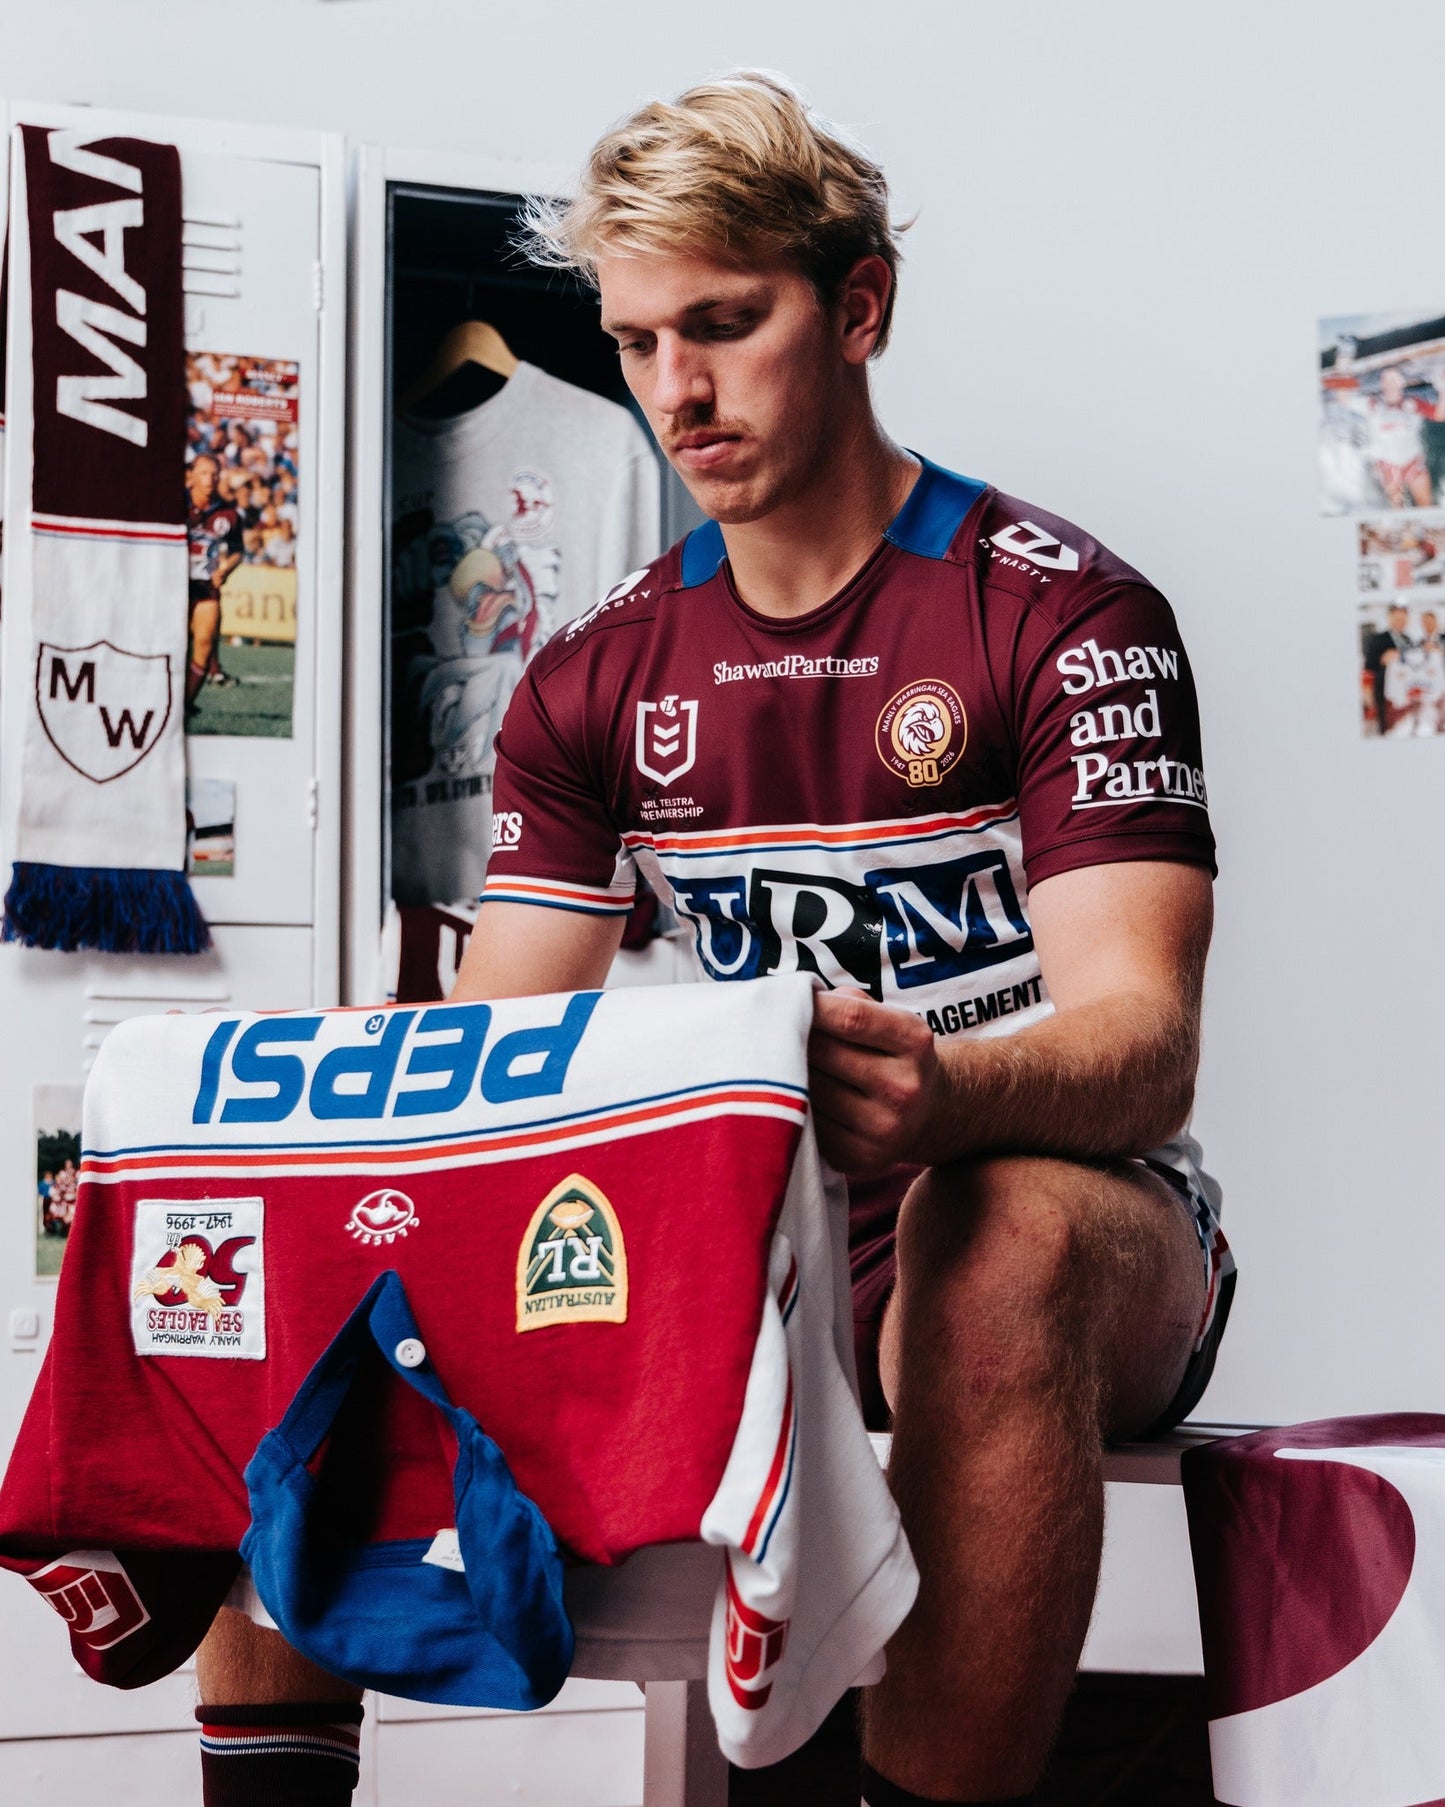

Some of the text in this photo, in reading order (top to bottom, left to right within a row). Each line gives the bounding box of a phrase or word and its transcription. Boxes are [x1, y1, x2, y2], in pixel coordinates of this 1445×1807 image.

[978, 538, 1051, 583] DYNASTY
[49, 657, 96, 704] M
[1056, 638, 1178, 696] Shaw
[100, 706, 154, 749] W
[881, 684, 962, 733] MANLY WARRINGAH SEA EAGLES
[1069, 689, 1162, 748] and
[890, 756, 906, 770] 1947
[908, 760, 940, 784] 80
[1070, 752, 1208, 803] Partne
[640, 806, 704, 821] PREMIERSHIP
[641, 797, 695, 810] NRL TELSTRA
[674, 863, 1029, 990] URM
[916, 974, 1042, 1037] AGEMENT
[192, 992, 605, 1125] PEPSI
[344, 1217, 420, 1246] CLASSIC
[537, 1236, 603, 1283] RL
[148, 1310, 243, 1333] SEA EAGLES
[525, 1291, 616, 1315] AUSTRALIAN
[152, 1333, 241, 1346] MANLY WARRINGAH
